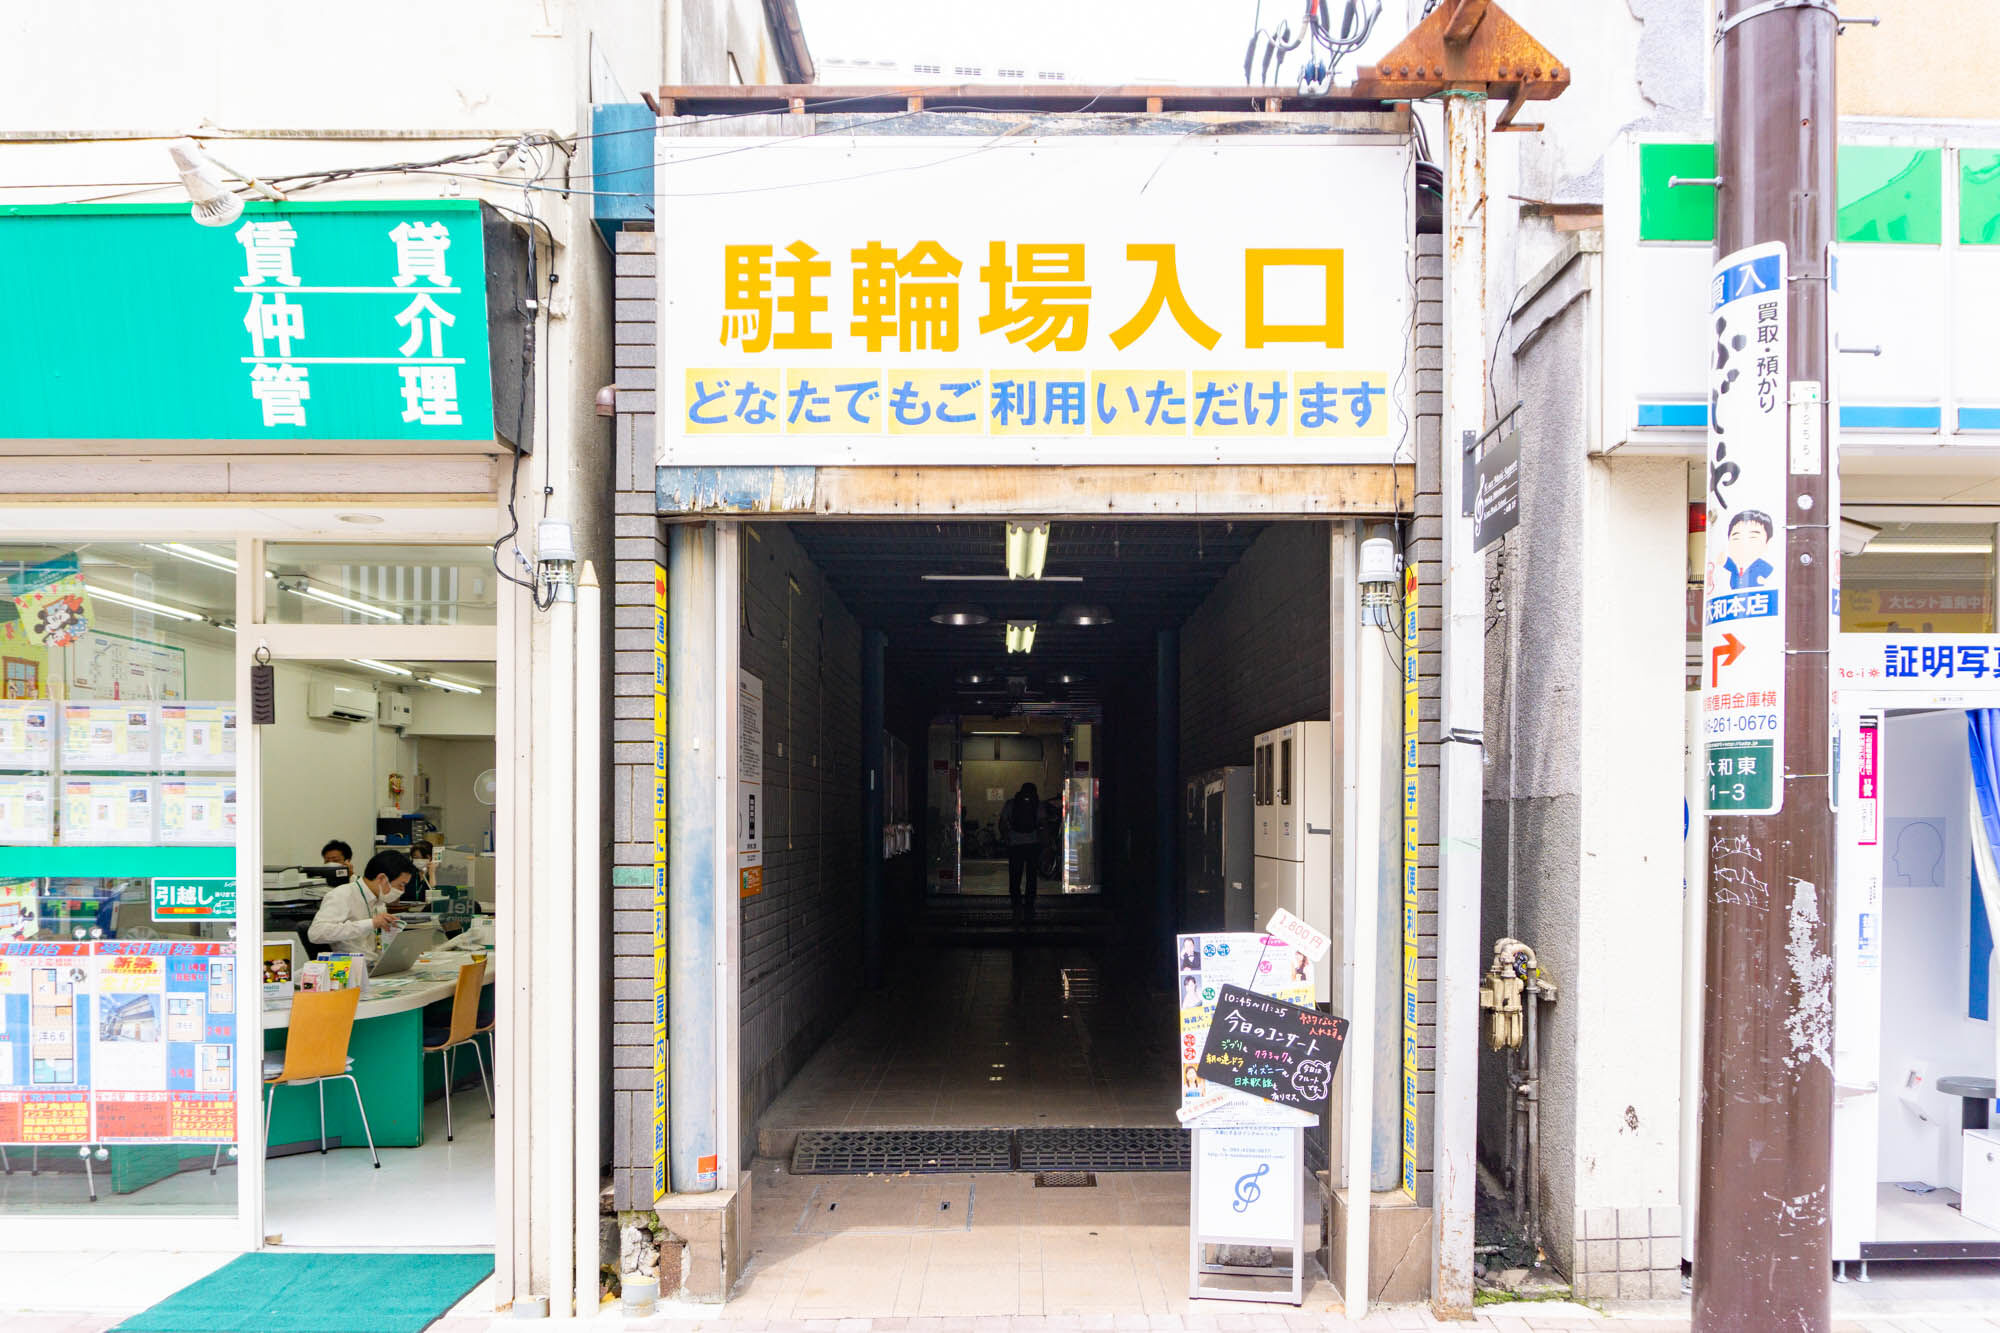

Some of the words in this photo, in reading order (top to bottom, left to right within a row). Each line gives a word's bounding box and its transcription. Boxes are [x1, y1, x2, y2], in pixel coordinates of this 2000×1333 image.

[235, 220, 453, 287] 賃貸
[719, 239, 1345, 353] 駐輪場入口
[243, 292, 456, 358] 仲介
[1756, 301, 1780, 414] 買取・預かり
[249, 363, 463, 427] 管理
[687, 378, 1387, 429] どなたでもご利用いただけます
[1883, 644, 2000, 678] 証明写
[1706, 756, 1758, 777] 大和東
[1710, 783, 1746, 802] 1-3
[156, 885, 214, 905] 引越し
[1223, 1008, 1321, 1057] 今日のコンサート
